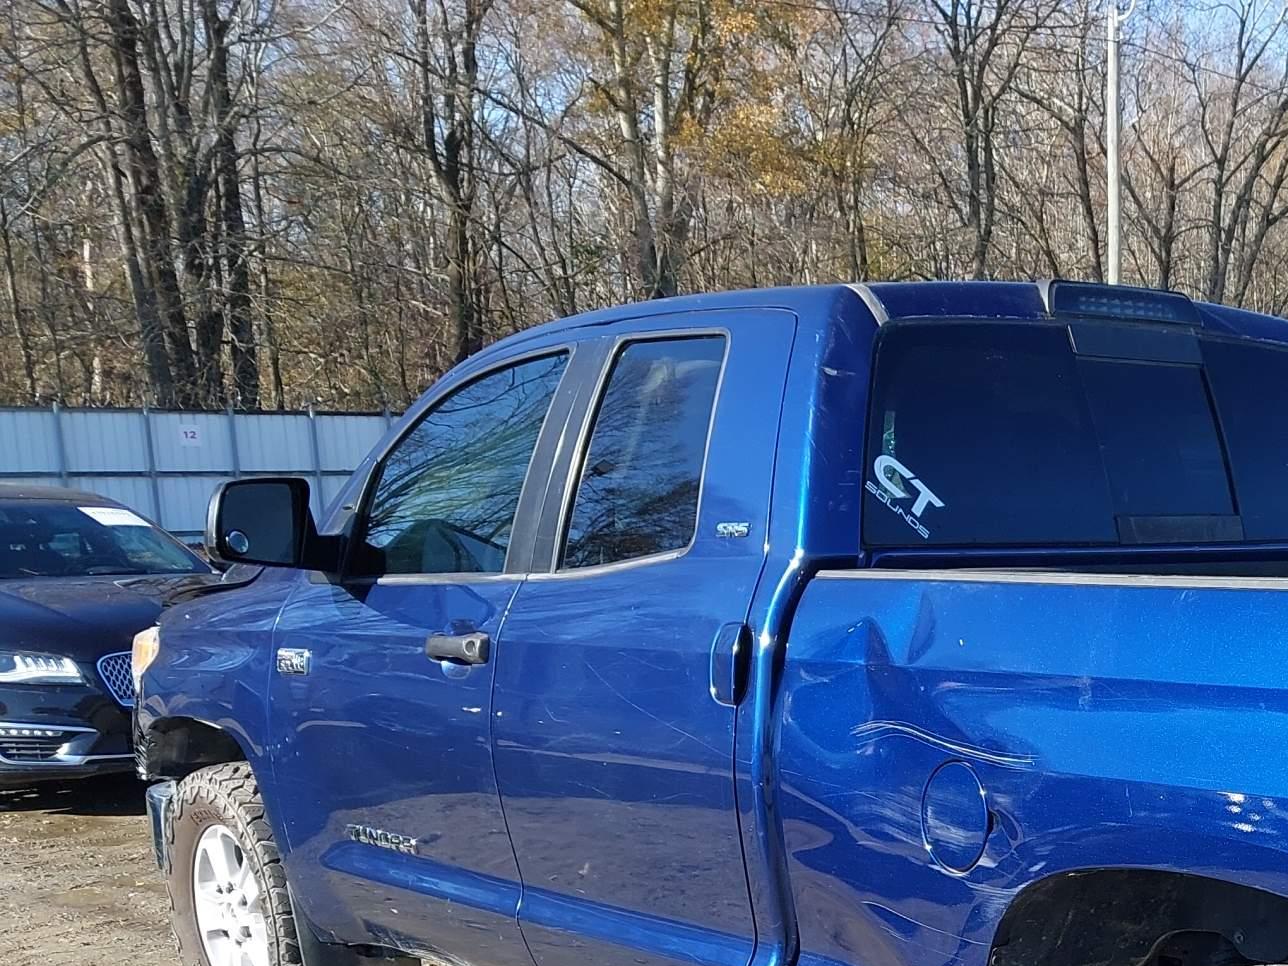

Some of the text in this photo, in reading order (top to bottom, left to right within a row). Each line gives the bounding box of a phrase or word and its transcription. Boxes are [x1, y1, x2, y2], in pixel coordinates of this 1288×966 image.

[183, 430, 198, 440] 12
[874, 454, 946, 518] CT
[865, 480, 930, 539] SOUNDS
[715, 522, 750, 537] SR5
[345, 823, 418, 856] TUNDRA
